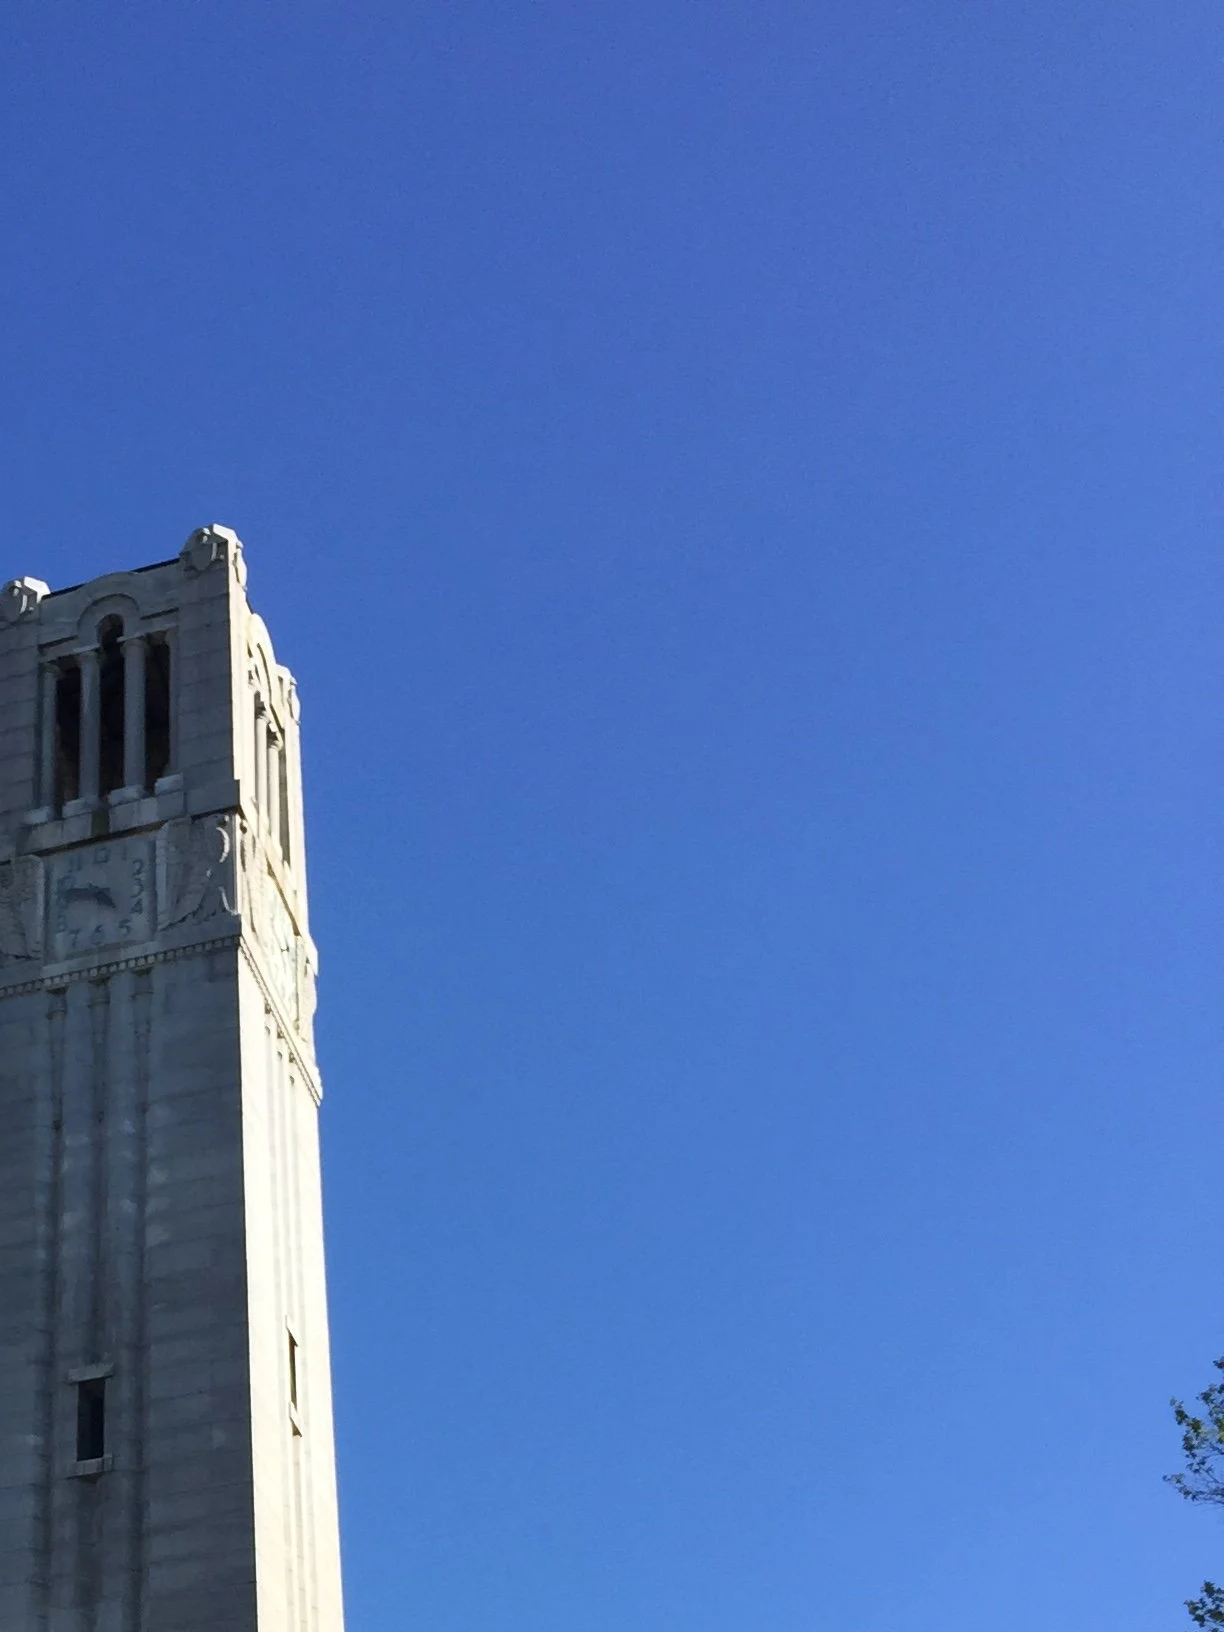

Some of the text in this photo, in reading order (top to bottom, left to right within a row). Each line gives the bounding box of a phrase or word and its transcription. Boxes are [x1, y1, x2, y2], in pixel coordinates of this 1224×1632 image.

[131, 859, 144, 876] 2
[130, 878, 145, 898] 3
[129, 898, 144, 915] 4
[90, 924, 106, 945] 6
[118, 919, 132, 936] 5
[68, 929, 82, 949] 7
